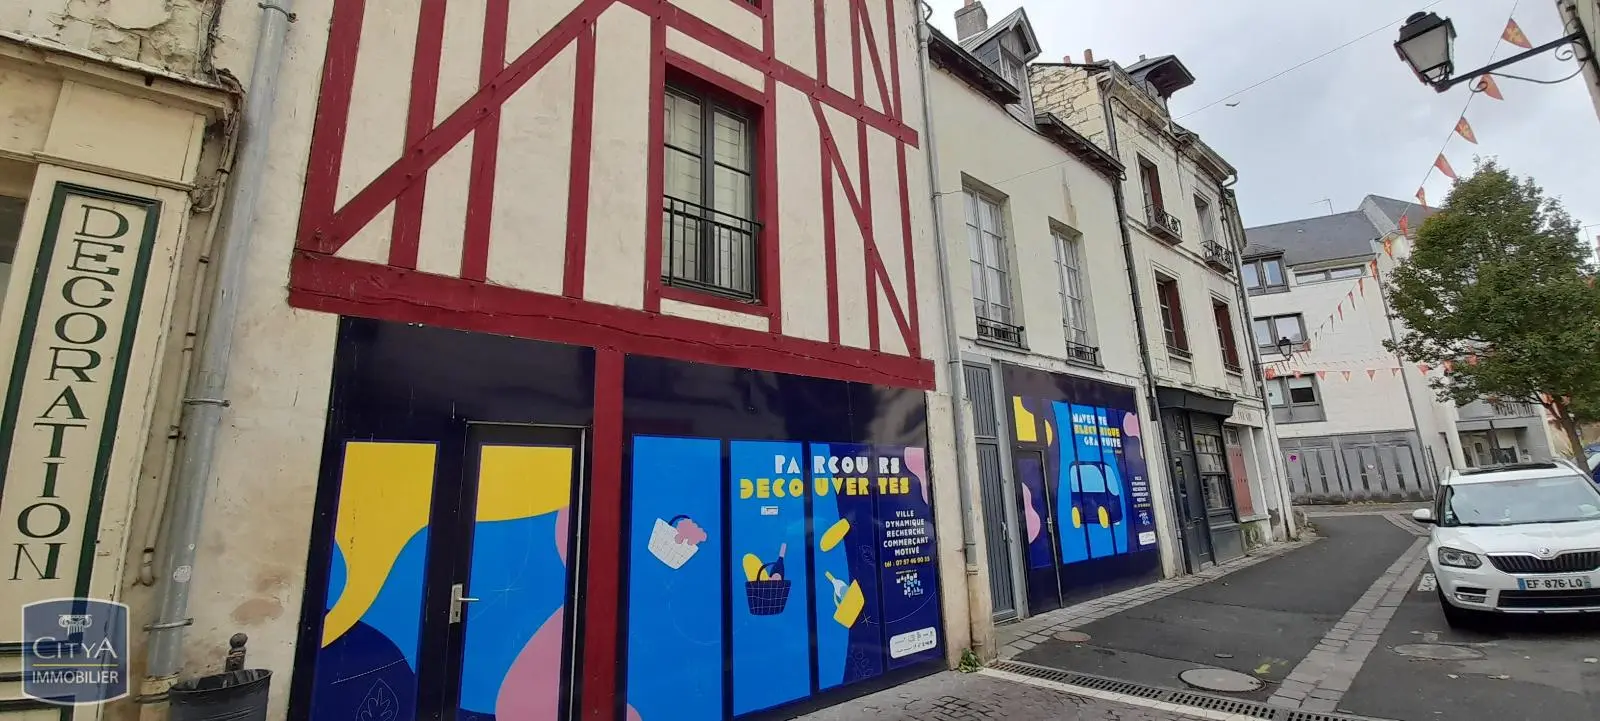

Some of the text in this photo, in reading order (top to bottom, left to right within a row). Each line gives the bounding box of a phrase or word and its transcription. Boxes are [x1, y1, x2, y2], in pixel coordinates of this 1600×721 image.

[8, 204, 129, 580] DECORATION
[885, 519, 925, 528] DYNAMIQUE
[886, 528, 925, 538] RECHERCHE
[883, 536, 929, 548] COMMERÇANT
[894, 546, 919, 556] MOTIVÉ
